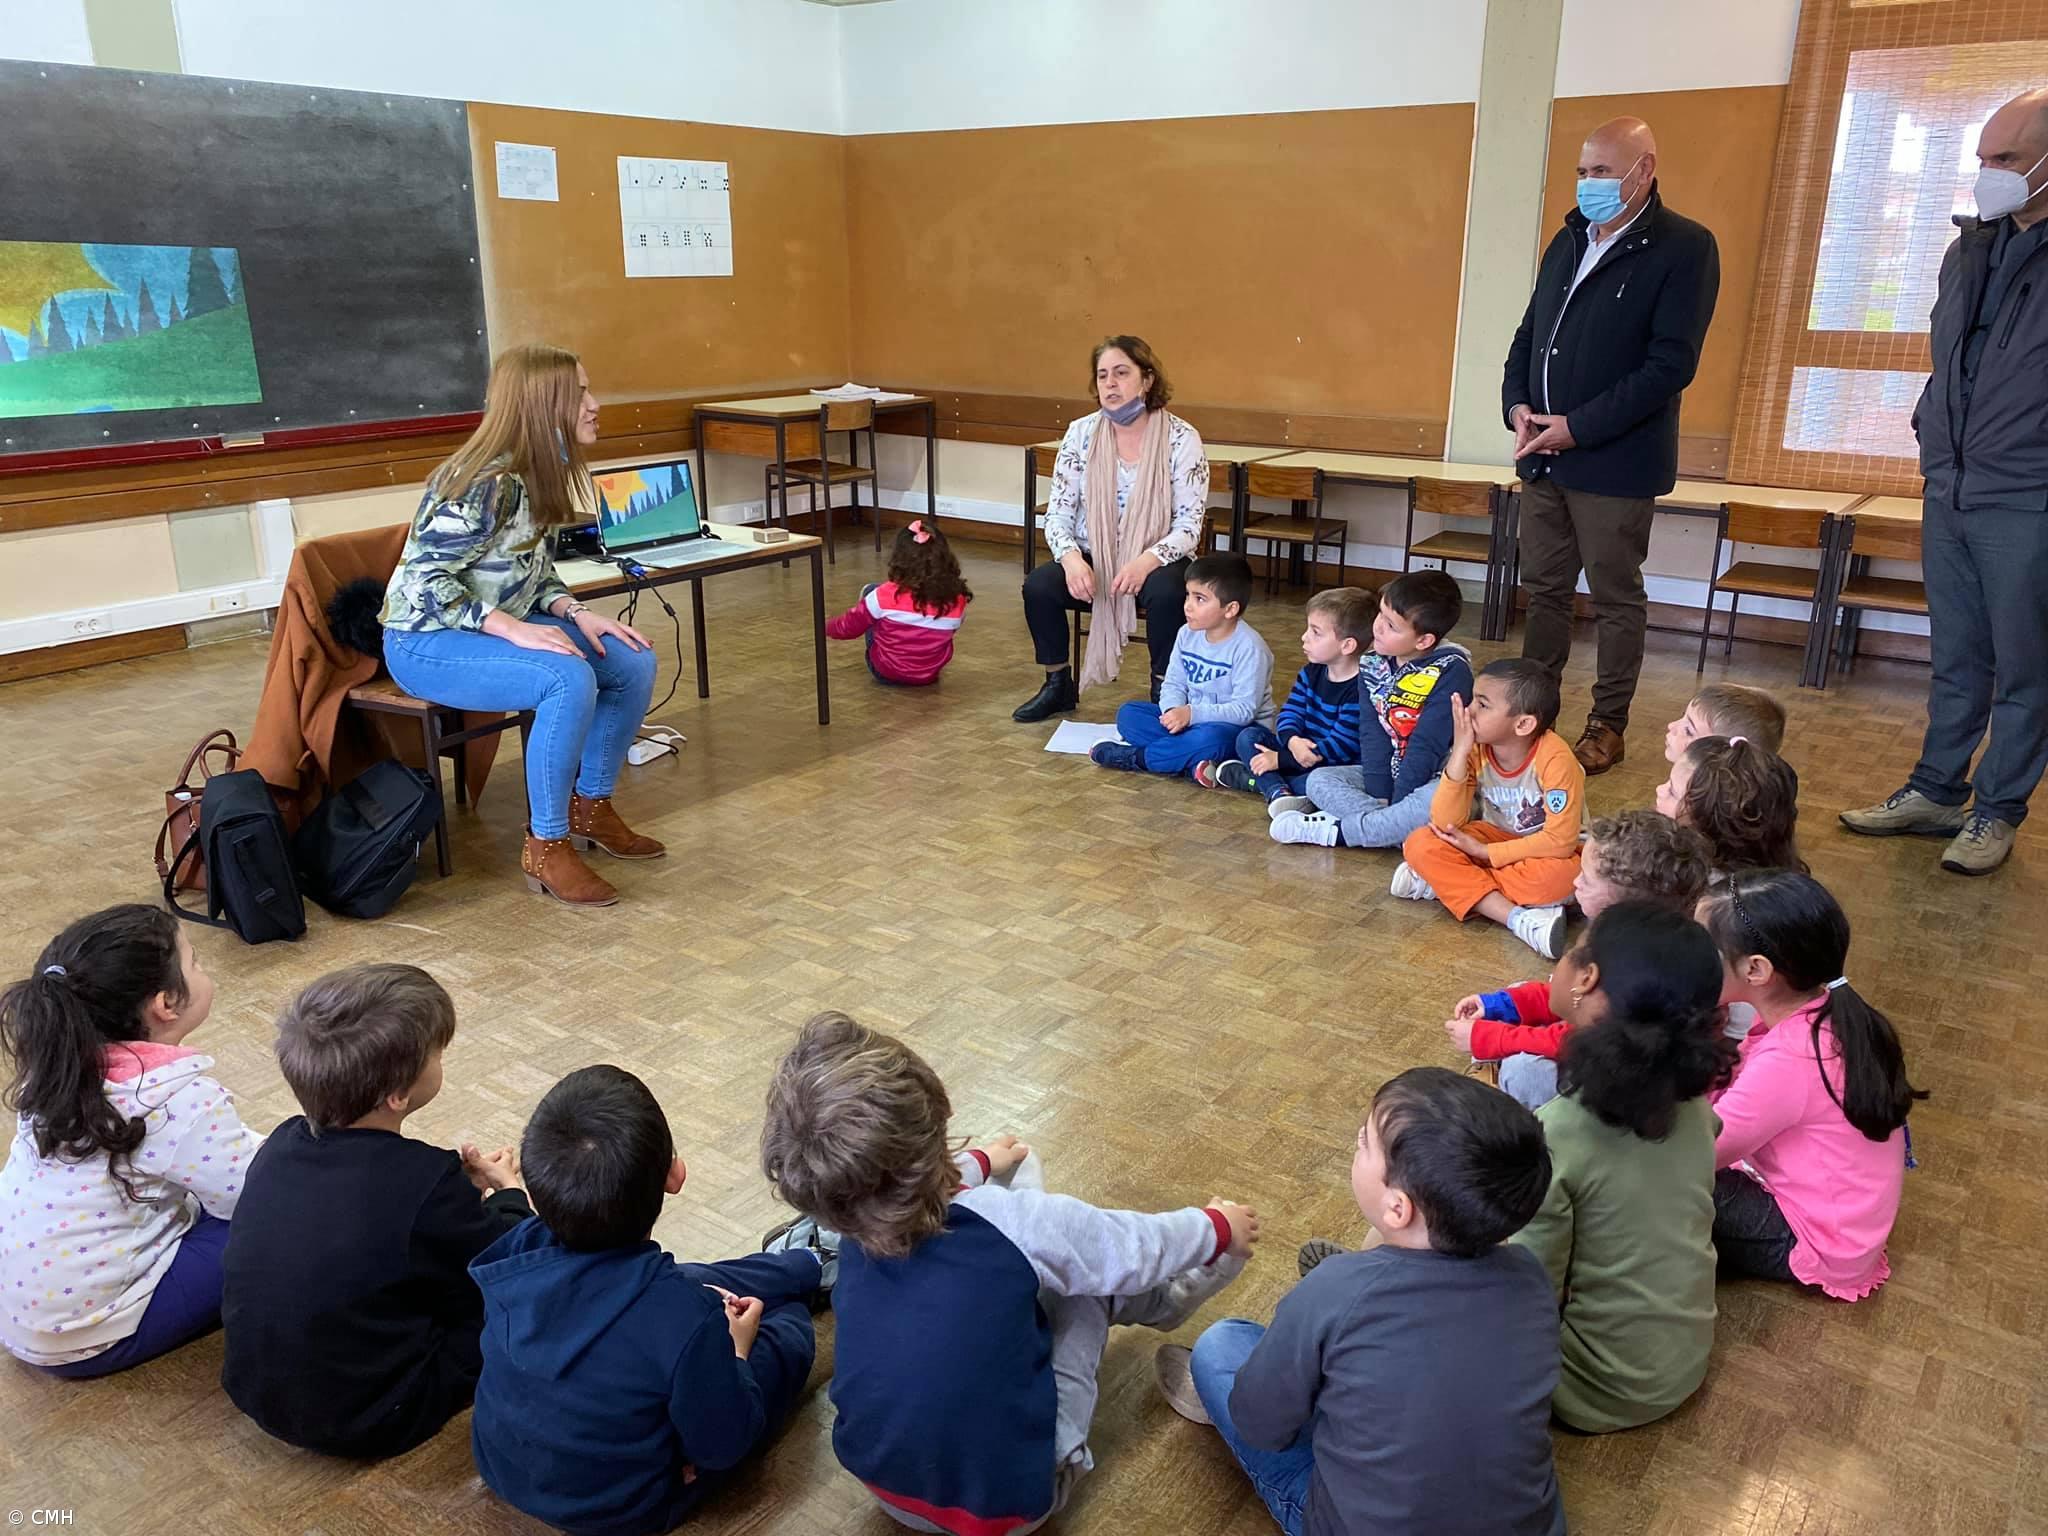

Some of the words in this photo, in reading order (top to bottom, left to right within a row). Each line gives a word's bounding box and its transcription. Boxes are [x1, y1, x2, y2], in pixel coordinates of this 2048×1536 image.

[648, 163, 661, 188] 2
[669, 164, 681, 190] 3
[690, 166, 700, 191] 4
